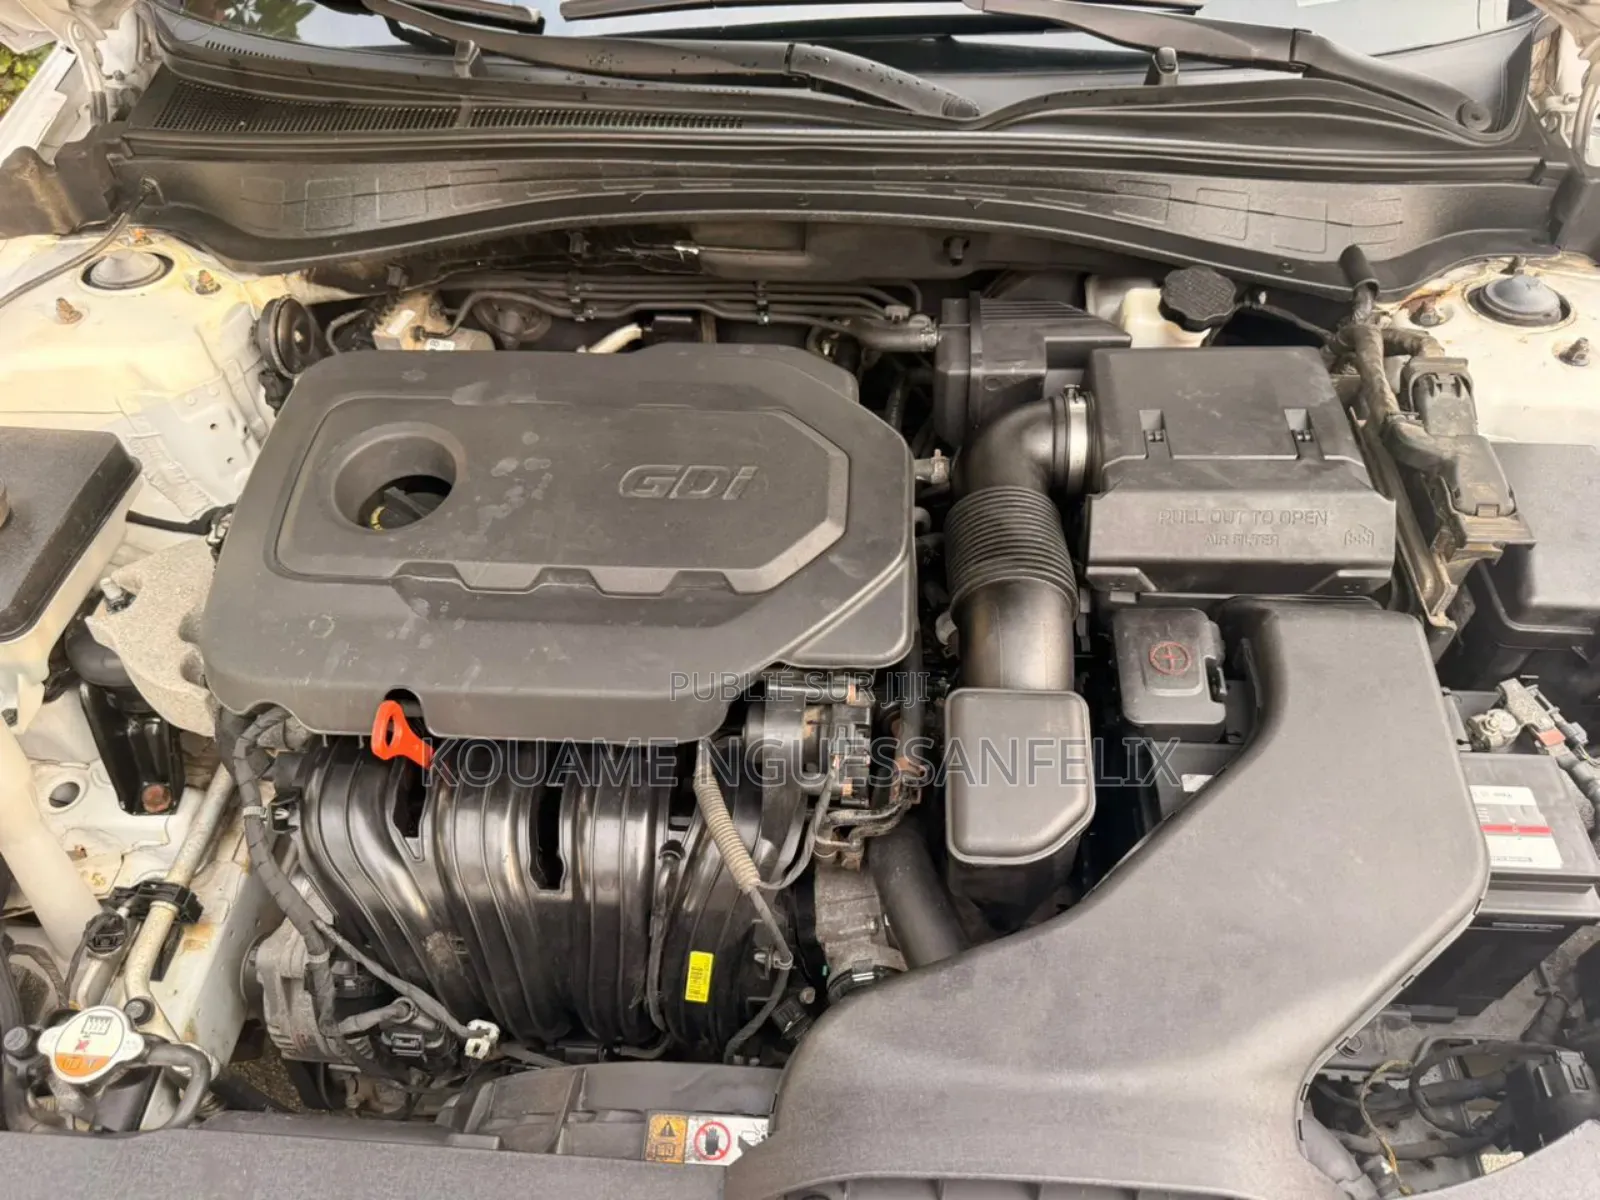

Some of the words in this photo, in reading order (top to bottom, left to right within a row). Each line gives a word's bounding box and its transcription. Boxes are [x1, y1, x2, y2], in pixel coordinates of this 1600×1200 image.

[1159, 509, 1205, 525] PULL
[1210, 509, 1246, 525] OUT
[1252, 509, 1275, 525] TO
[1279, 509, 1328, 526] OPEN
[1205, 533, 1229, 547] AIR
[1232, 533, 1280, 547] FILTER
